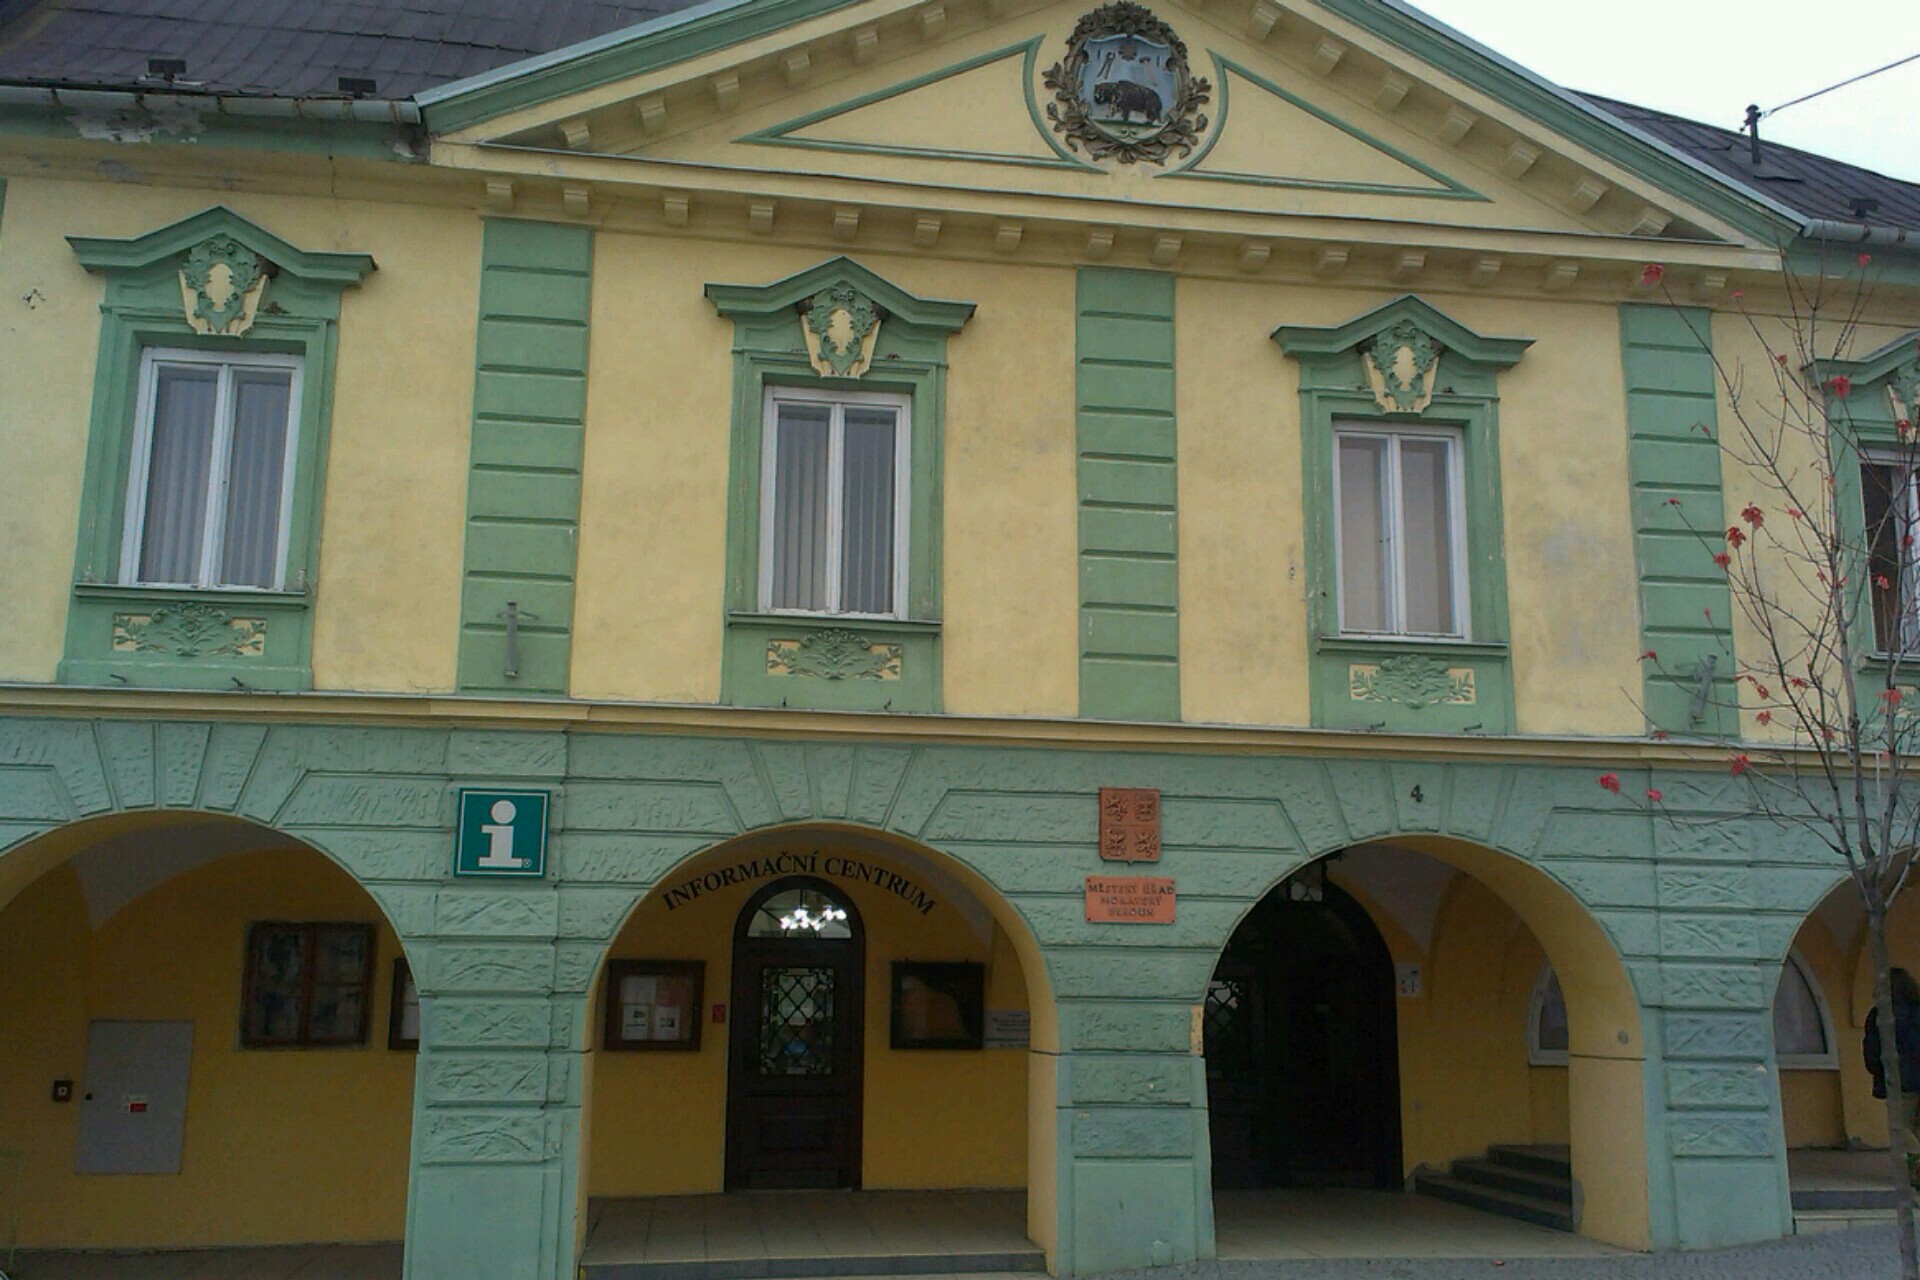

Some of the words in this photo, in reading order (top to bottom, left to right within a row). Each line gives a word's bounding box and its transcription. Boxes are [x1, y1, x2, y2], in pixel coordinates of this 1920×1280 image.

[1410, 784, 1424, 803] 4
[662, 851, 818, 911] INFORMAČNÍ
[824, 858, 937, 916] CENTRUM
